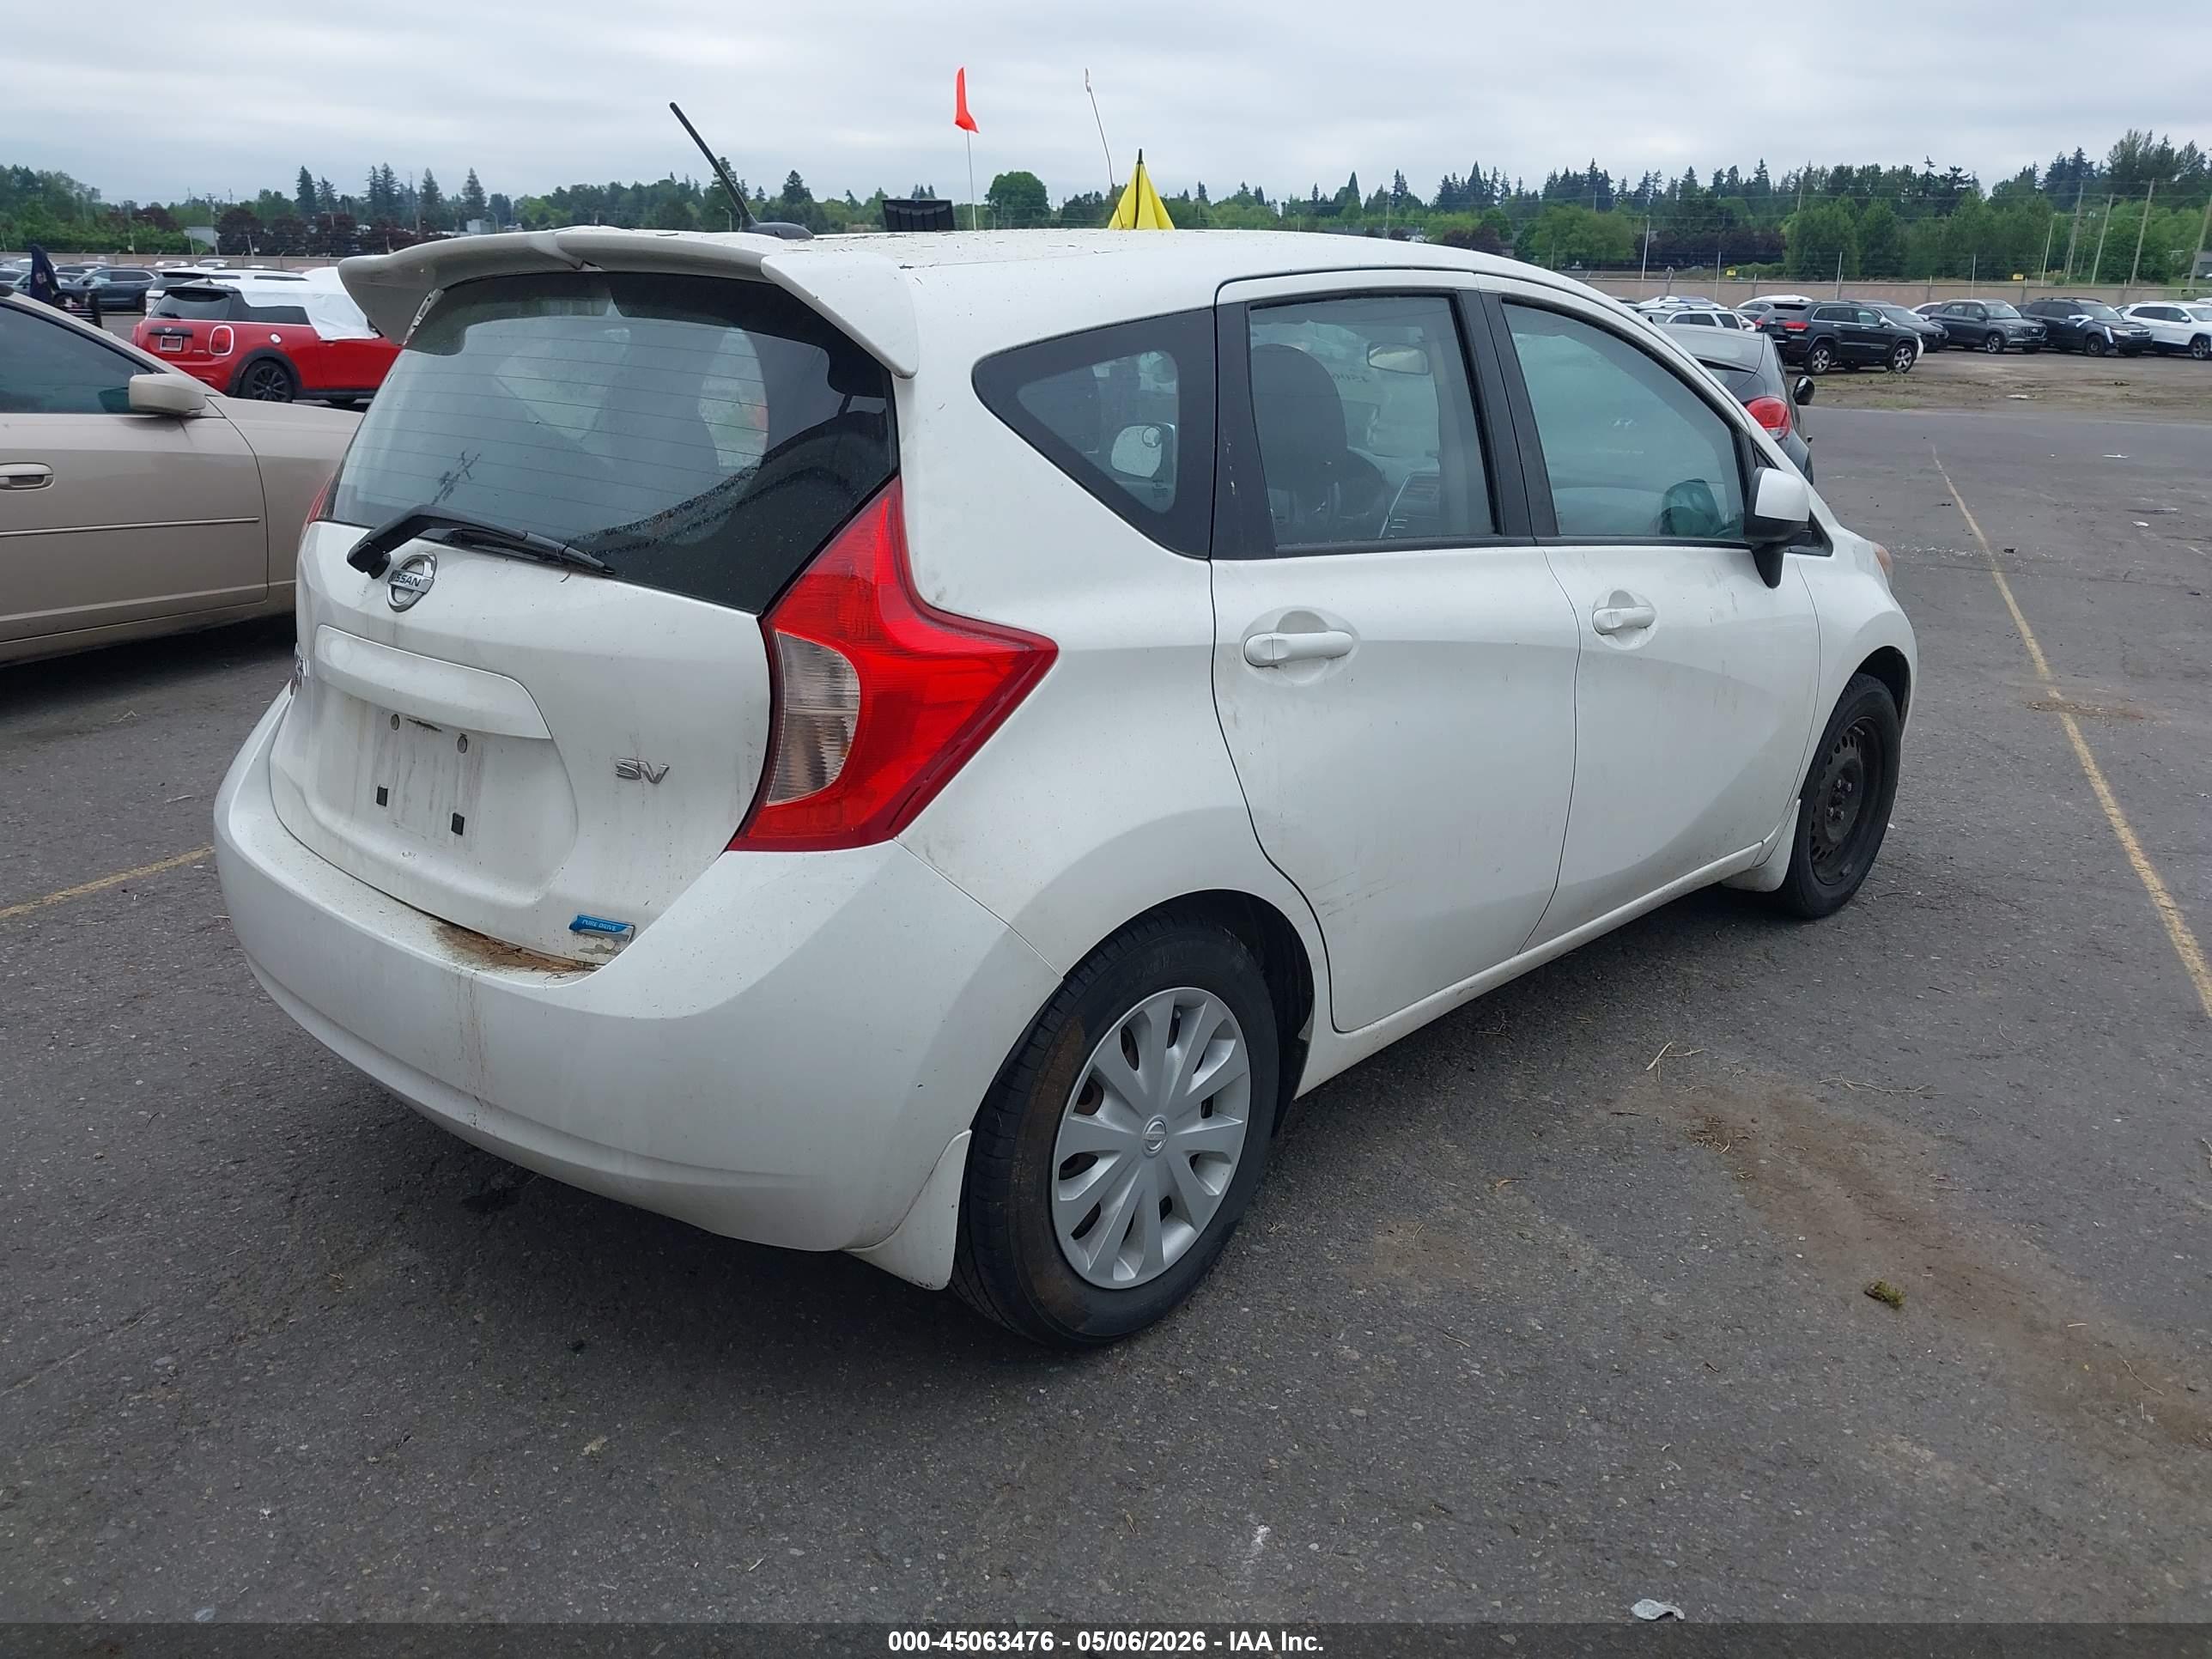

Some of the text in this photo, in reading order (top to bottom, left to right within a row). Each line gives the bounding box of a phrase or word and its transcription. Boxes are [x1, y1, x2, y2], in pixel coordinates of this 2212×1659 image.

[615, 758, 670, 784] SV
[581, 919, 617, 932] PURE DRIVE
